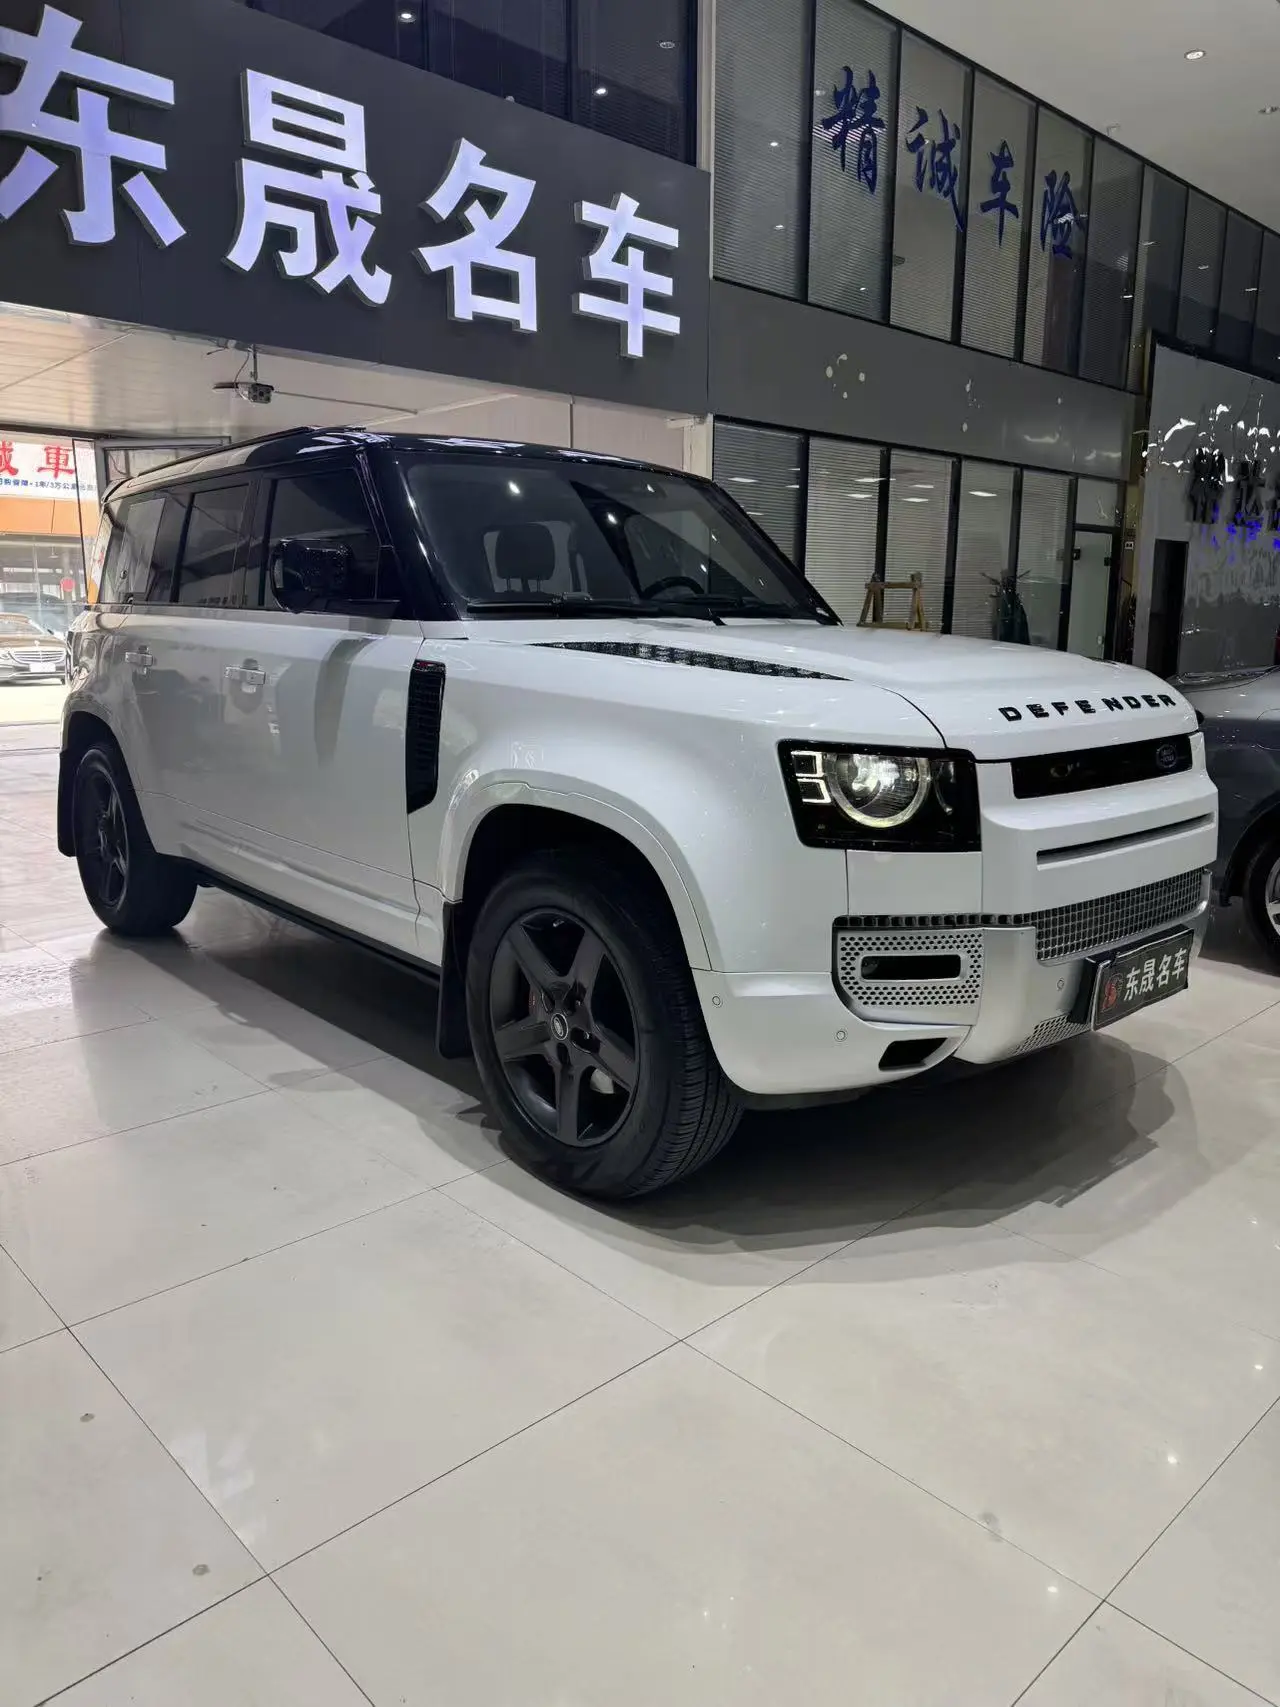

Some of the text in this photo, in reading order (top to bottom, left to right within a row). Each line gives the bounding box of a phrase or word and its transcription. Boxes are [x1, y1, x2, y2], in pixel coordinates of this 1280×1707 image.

[0, 4, 682, 358] 东晟名车
[998, 694, 1177, 722] DEFENDER
[1124, 947, 1188, 1001] 东晟名车
